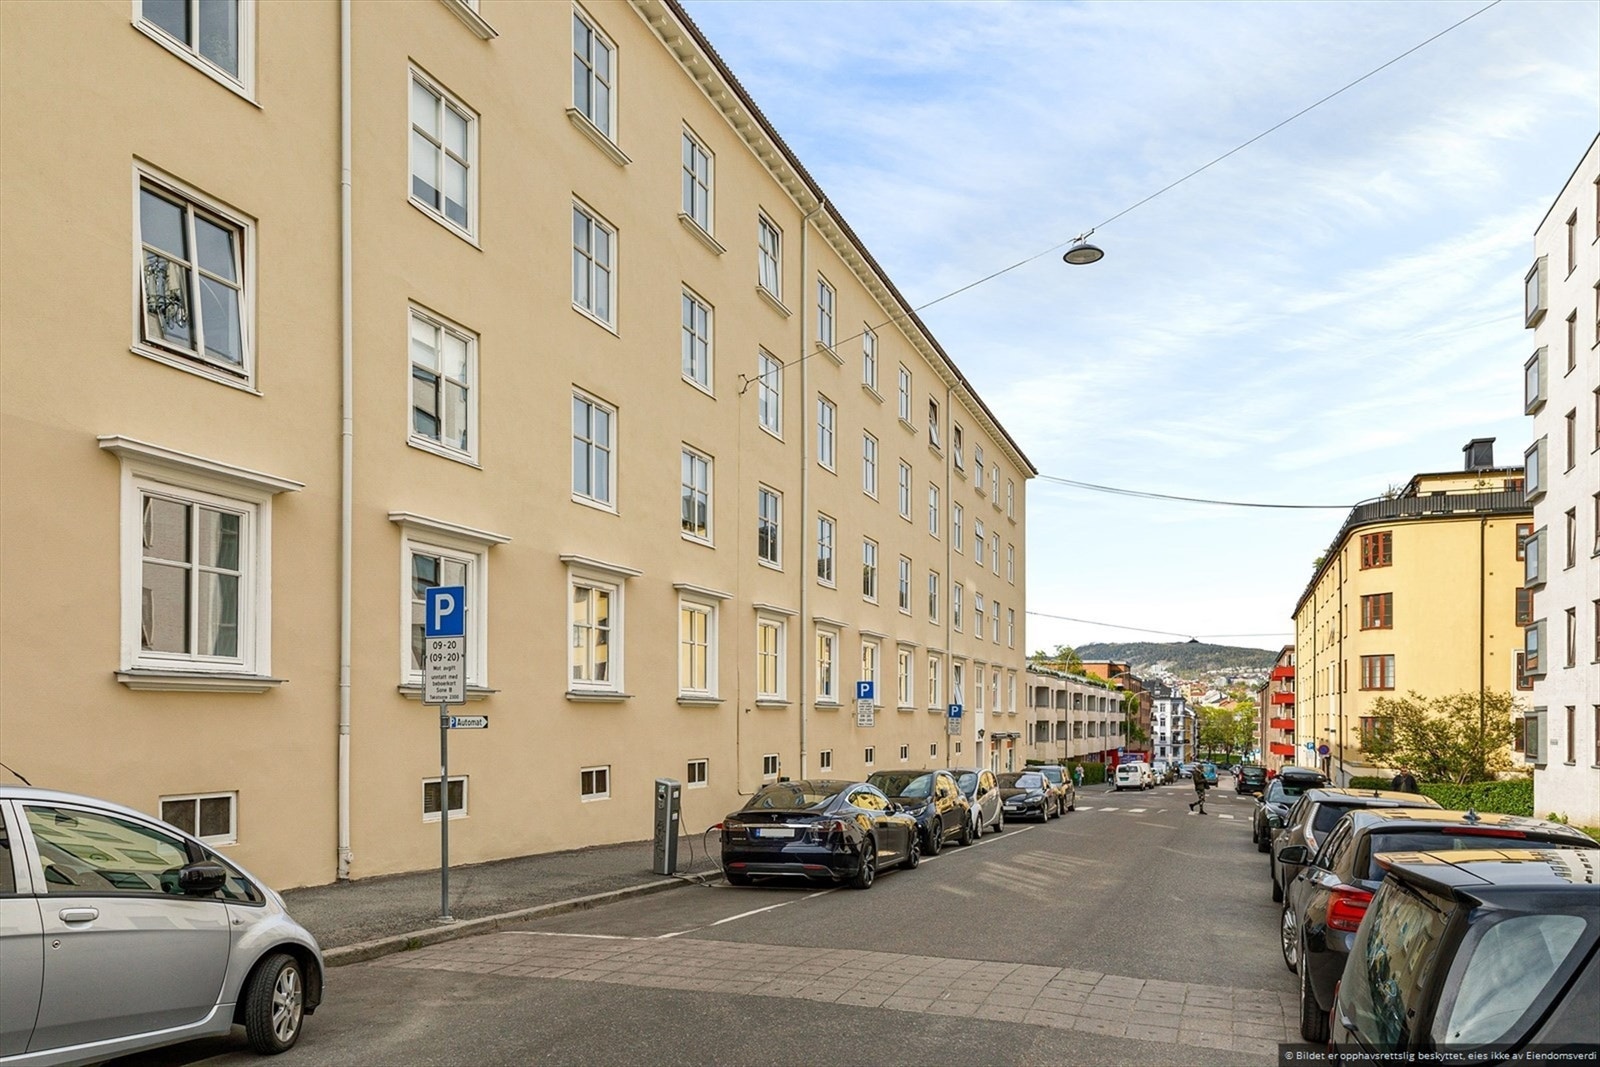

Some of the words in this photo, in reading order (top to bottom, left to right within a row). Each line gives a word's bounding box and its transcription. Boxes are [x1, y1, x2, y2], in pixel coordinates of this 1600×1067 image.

[435, 593, 455, 631] P
[860, 683, 870, 697] P
[951, 706, 959, 716] P
[457, 718, 483, 727] Automat
